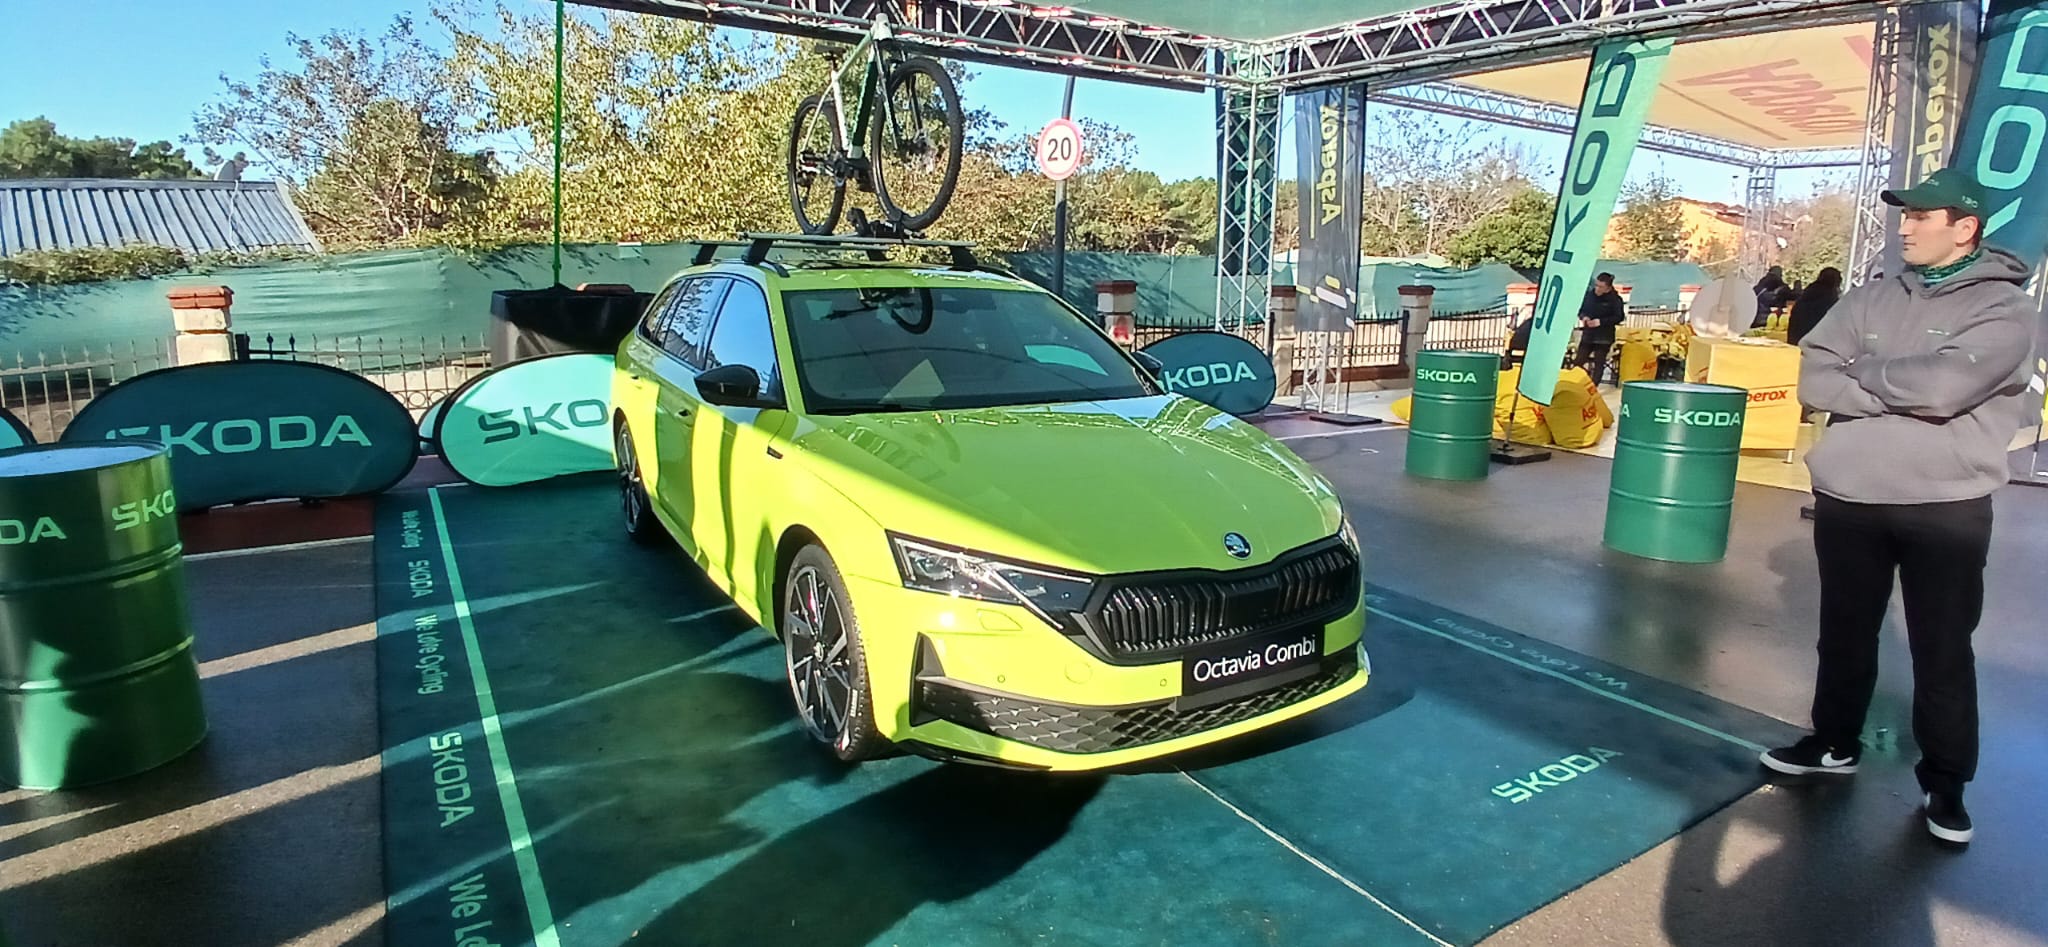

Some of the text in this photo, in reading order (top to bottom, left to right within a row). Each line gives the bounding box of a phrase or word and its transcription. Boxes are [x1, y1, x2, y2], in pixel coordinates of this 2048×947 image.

[1047, 136, 1072, 162] 20
[1156, 361, 1258, 391] KODA
[415, 654, 448, 695] Cycling
[1193, 634, 1316, 682] Octavia Combi
[449, 873, 488, 918] We
